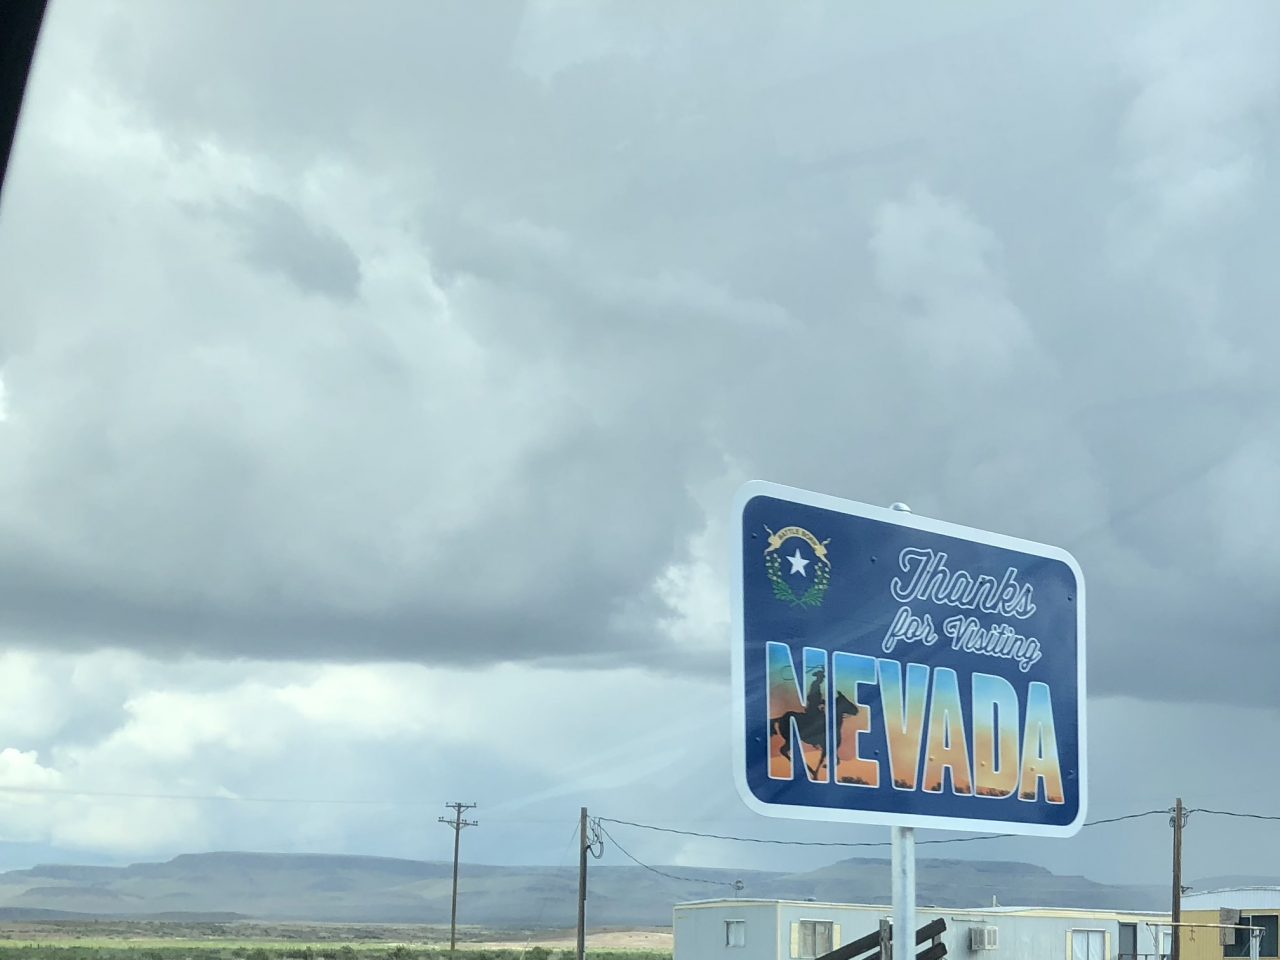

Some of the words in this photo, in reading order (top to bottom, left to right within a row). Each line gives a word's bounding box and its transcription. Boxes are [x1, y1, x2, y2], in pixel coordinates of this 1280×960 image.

[891, 547, 1036, 619] Thanks
[882, 606, 938, 653] for
[943, 615, 1042, 672] Visiting
[766, 641, 1065, 804] NEVADA
